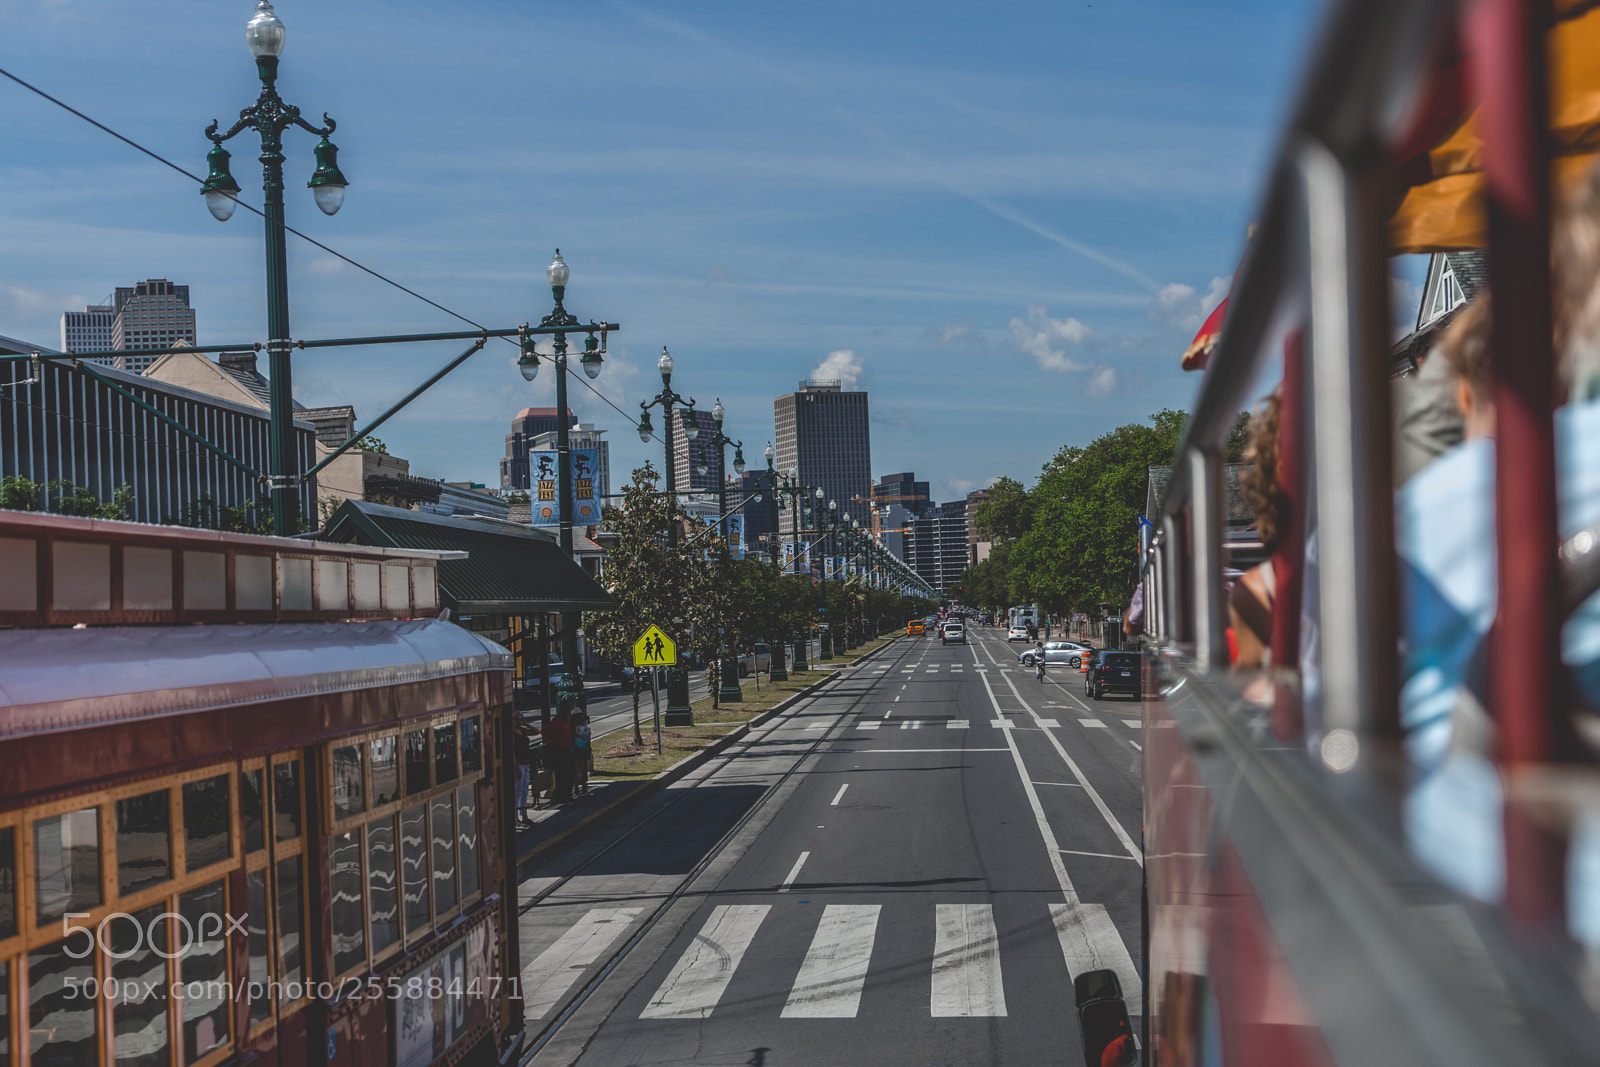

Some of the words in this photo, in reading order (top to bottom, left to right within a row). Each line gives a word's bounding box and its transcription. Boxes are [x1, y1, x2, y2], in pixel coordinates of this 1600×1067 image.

[576, 480, 591, 488] JAZZ
[539, 490, 554, 499] FEST
[577, 489, 592, 498] FEST
